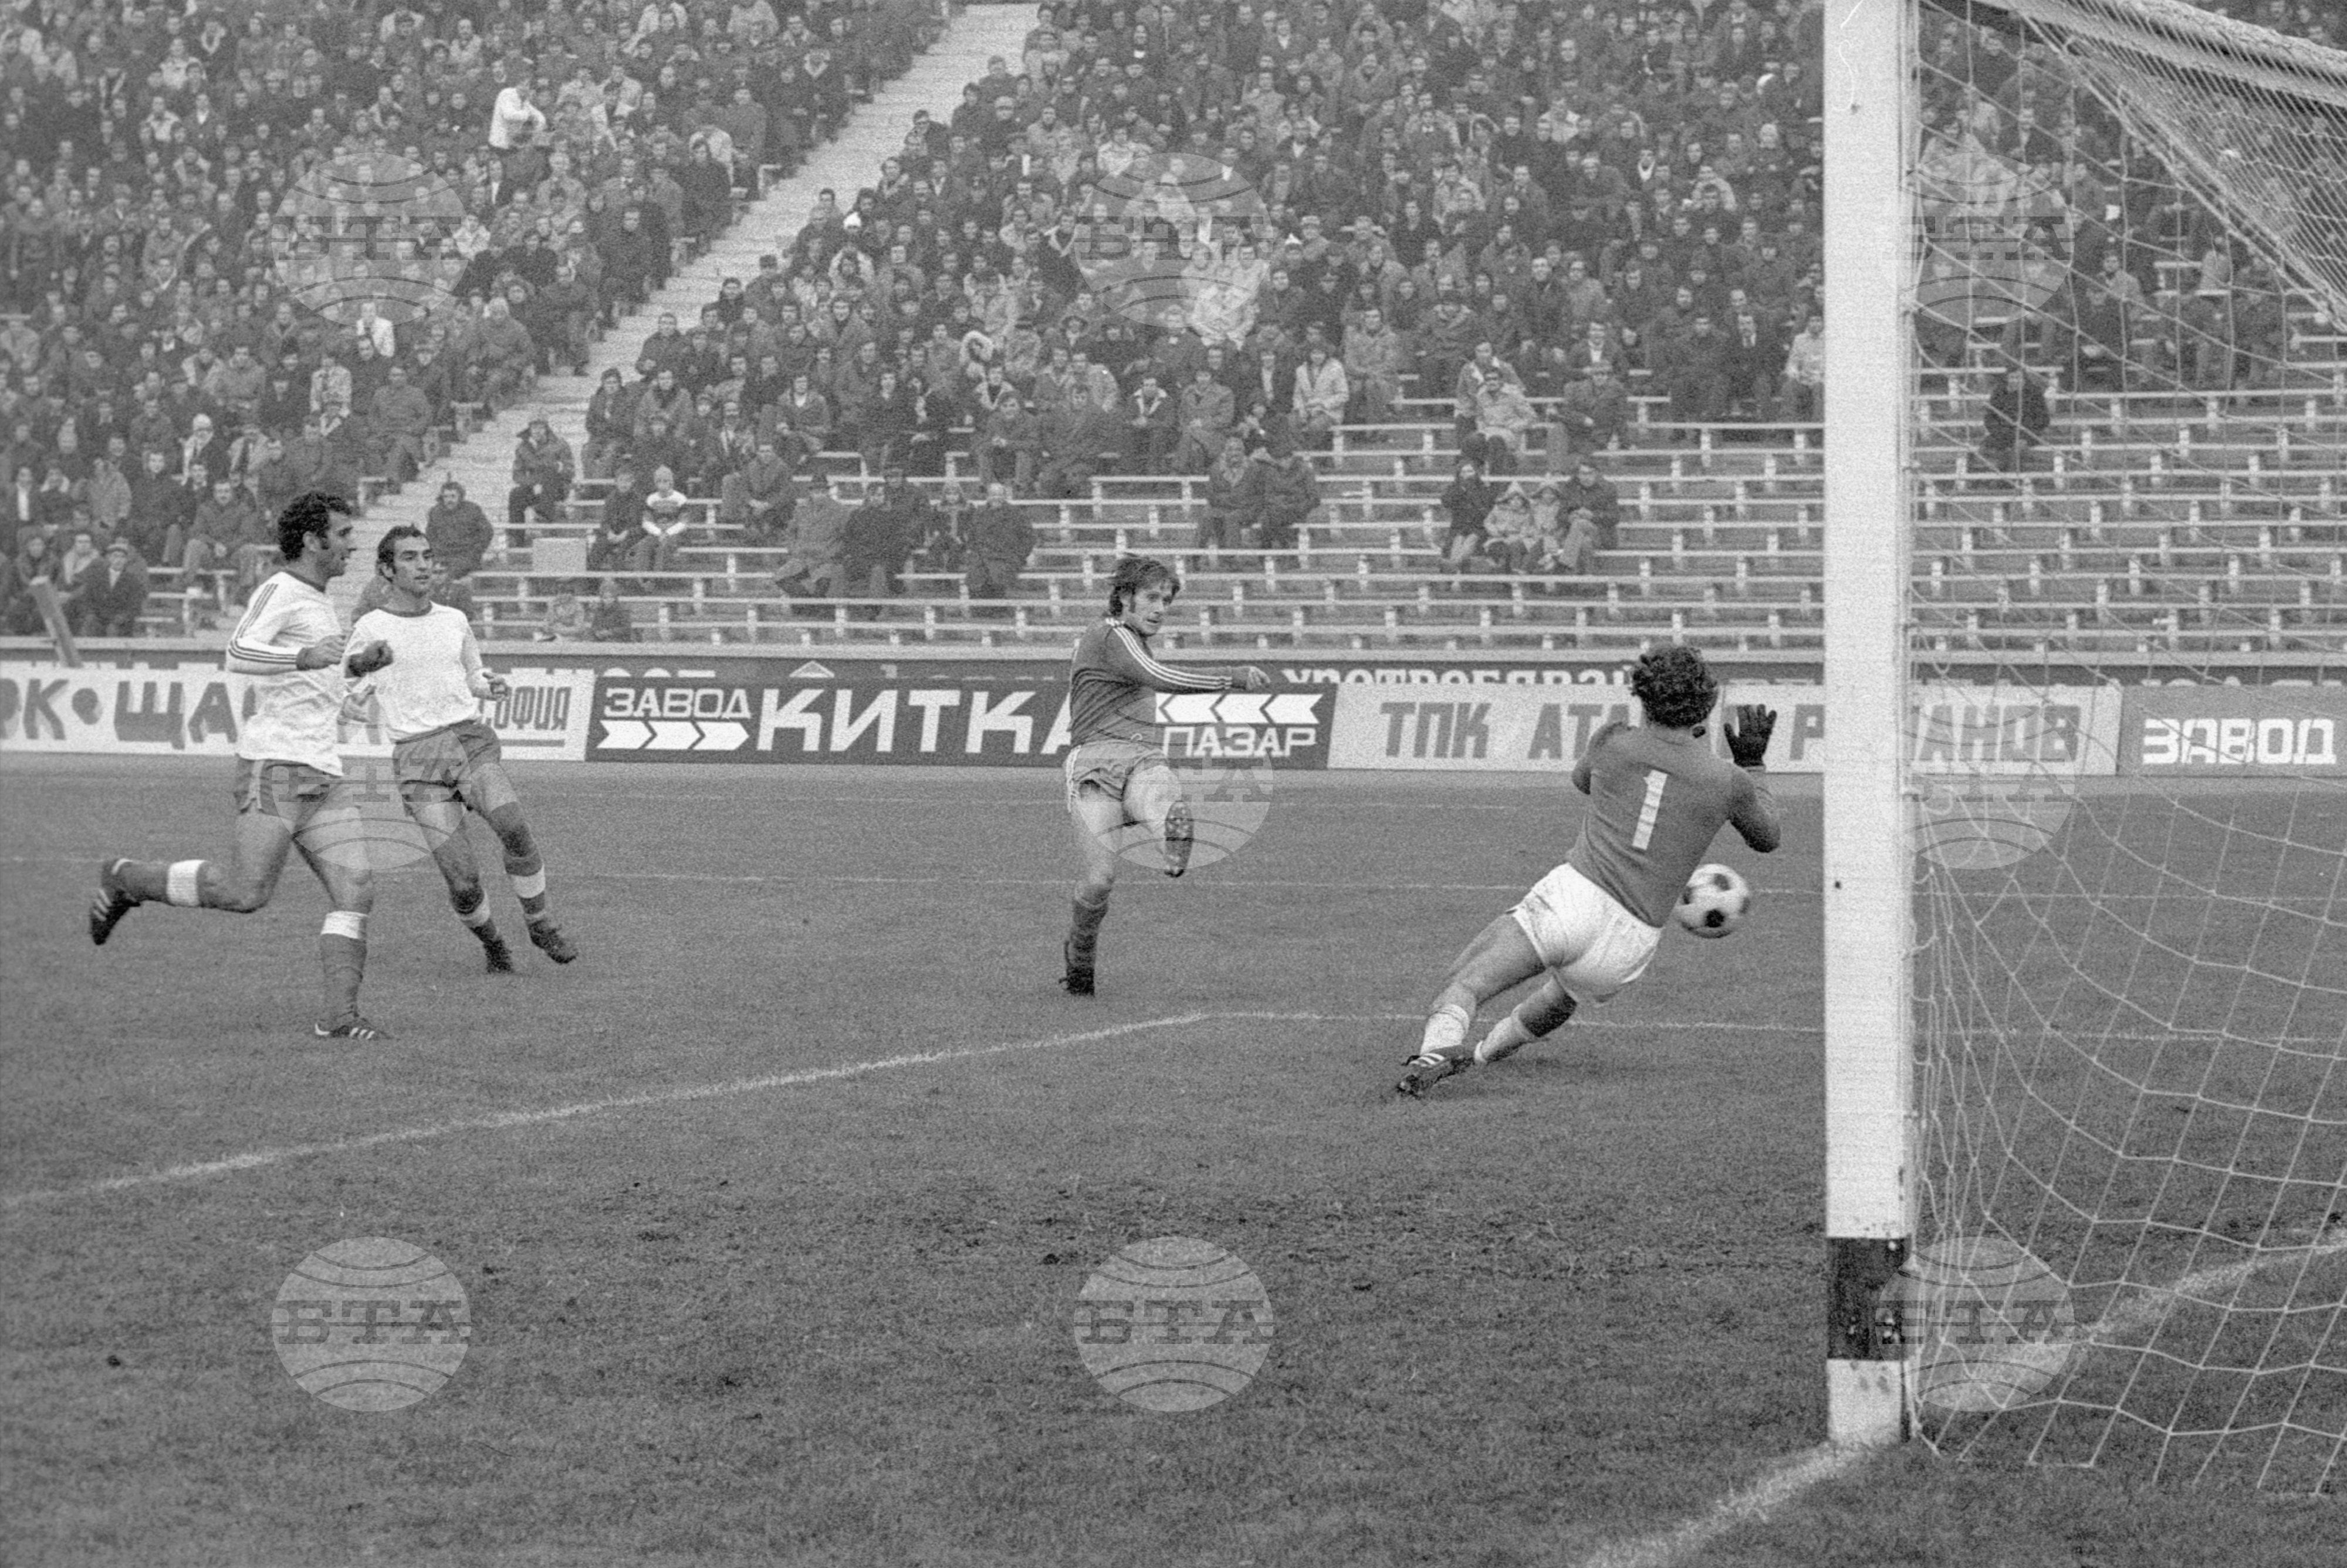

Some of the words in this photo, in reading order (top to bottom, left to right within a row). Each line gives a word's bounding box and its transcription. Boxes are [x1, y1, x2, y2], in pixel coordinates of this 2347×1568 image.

[604, 688, 752, 719] ЗАВОД
[1162, 726, 1317, 758] ПАЗАР
[1380, 703, 1492, 759] ТПК
[2142, 718, 2337, 764] ЗАВОД
[1632, 769, 1668, 851] 1
